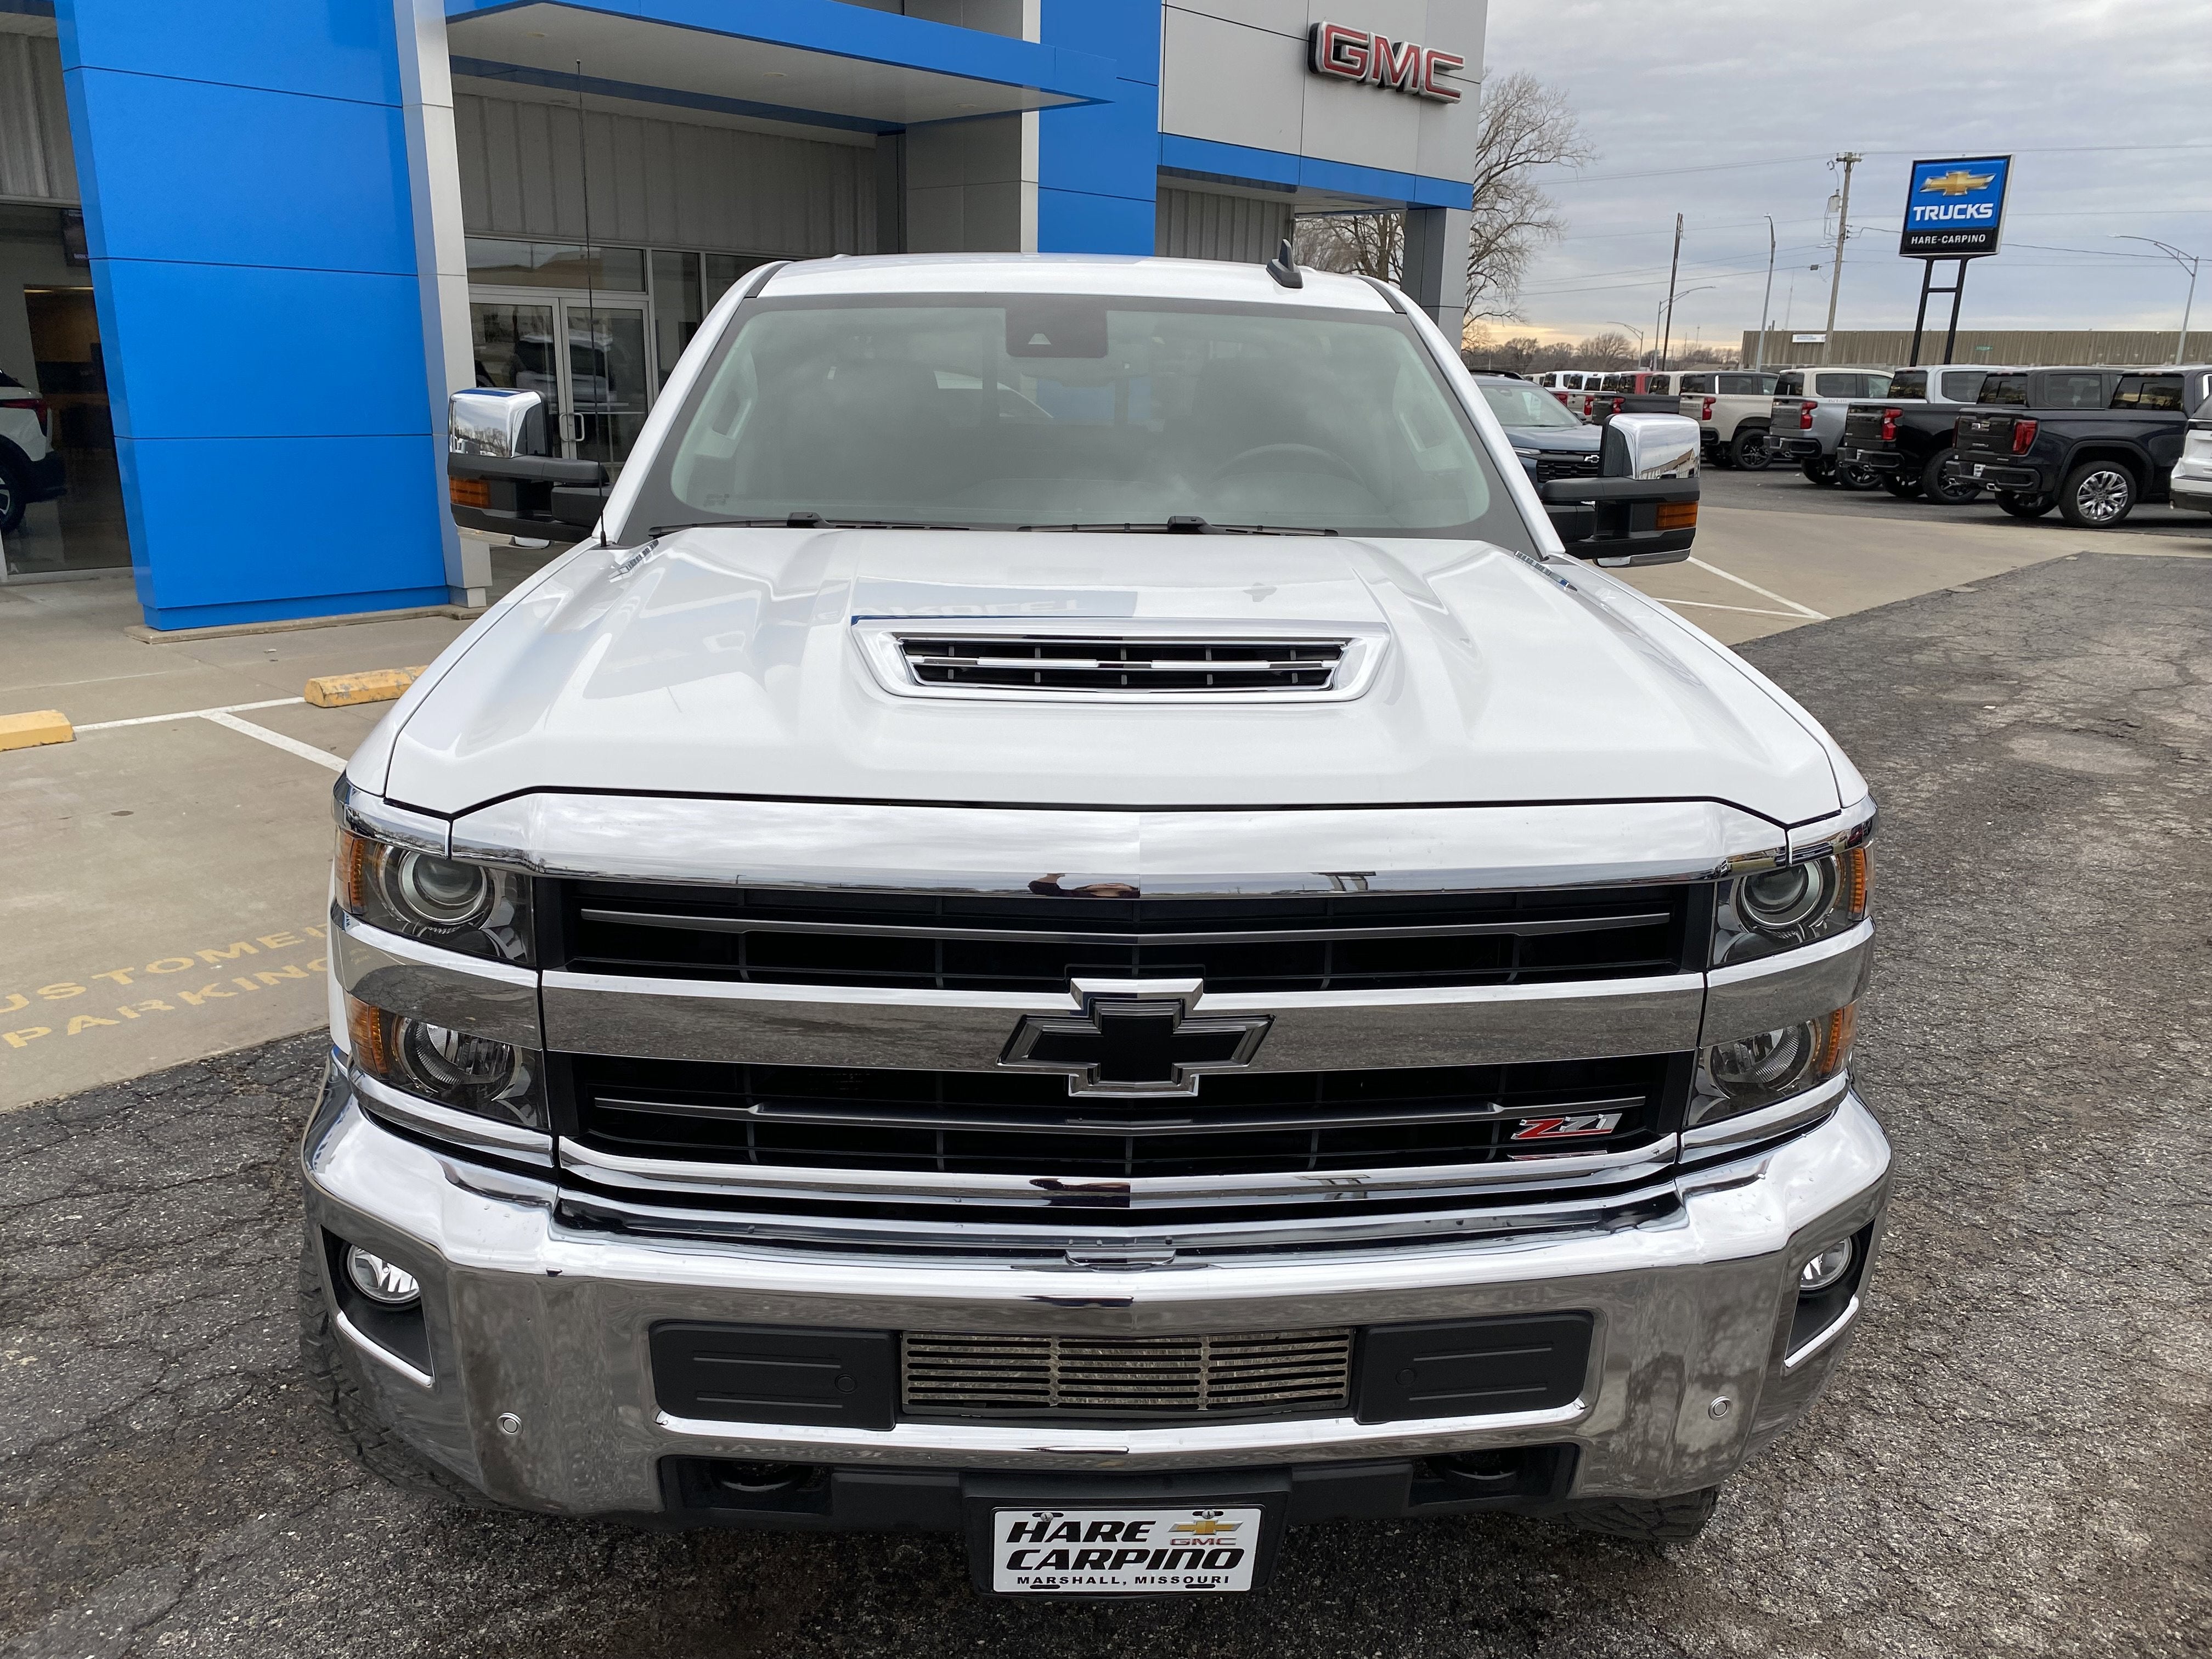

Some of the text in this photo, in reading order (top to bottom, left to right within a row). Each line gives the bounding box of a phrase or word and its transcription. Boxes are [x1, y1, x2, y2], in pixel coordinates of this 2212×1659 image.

[1310, 21, 1465, 104] GMC
[1913, 203, 1994, 221] TRUCKS
[1911, 234, 1986, 245] HARE-CARPINO
[1510, 1113, 1622, 1139] Z71
[1006, 1521, 1156, 1543] HARE
[1006, 1548, 1245, 1570] CARPINO
[1017, 1576, 1229, 1585] MARSHALL, MISSOURI
